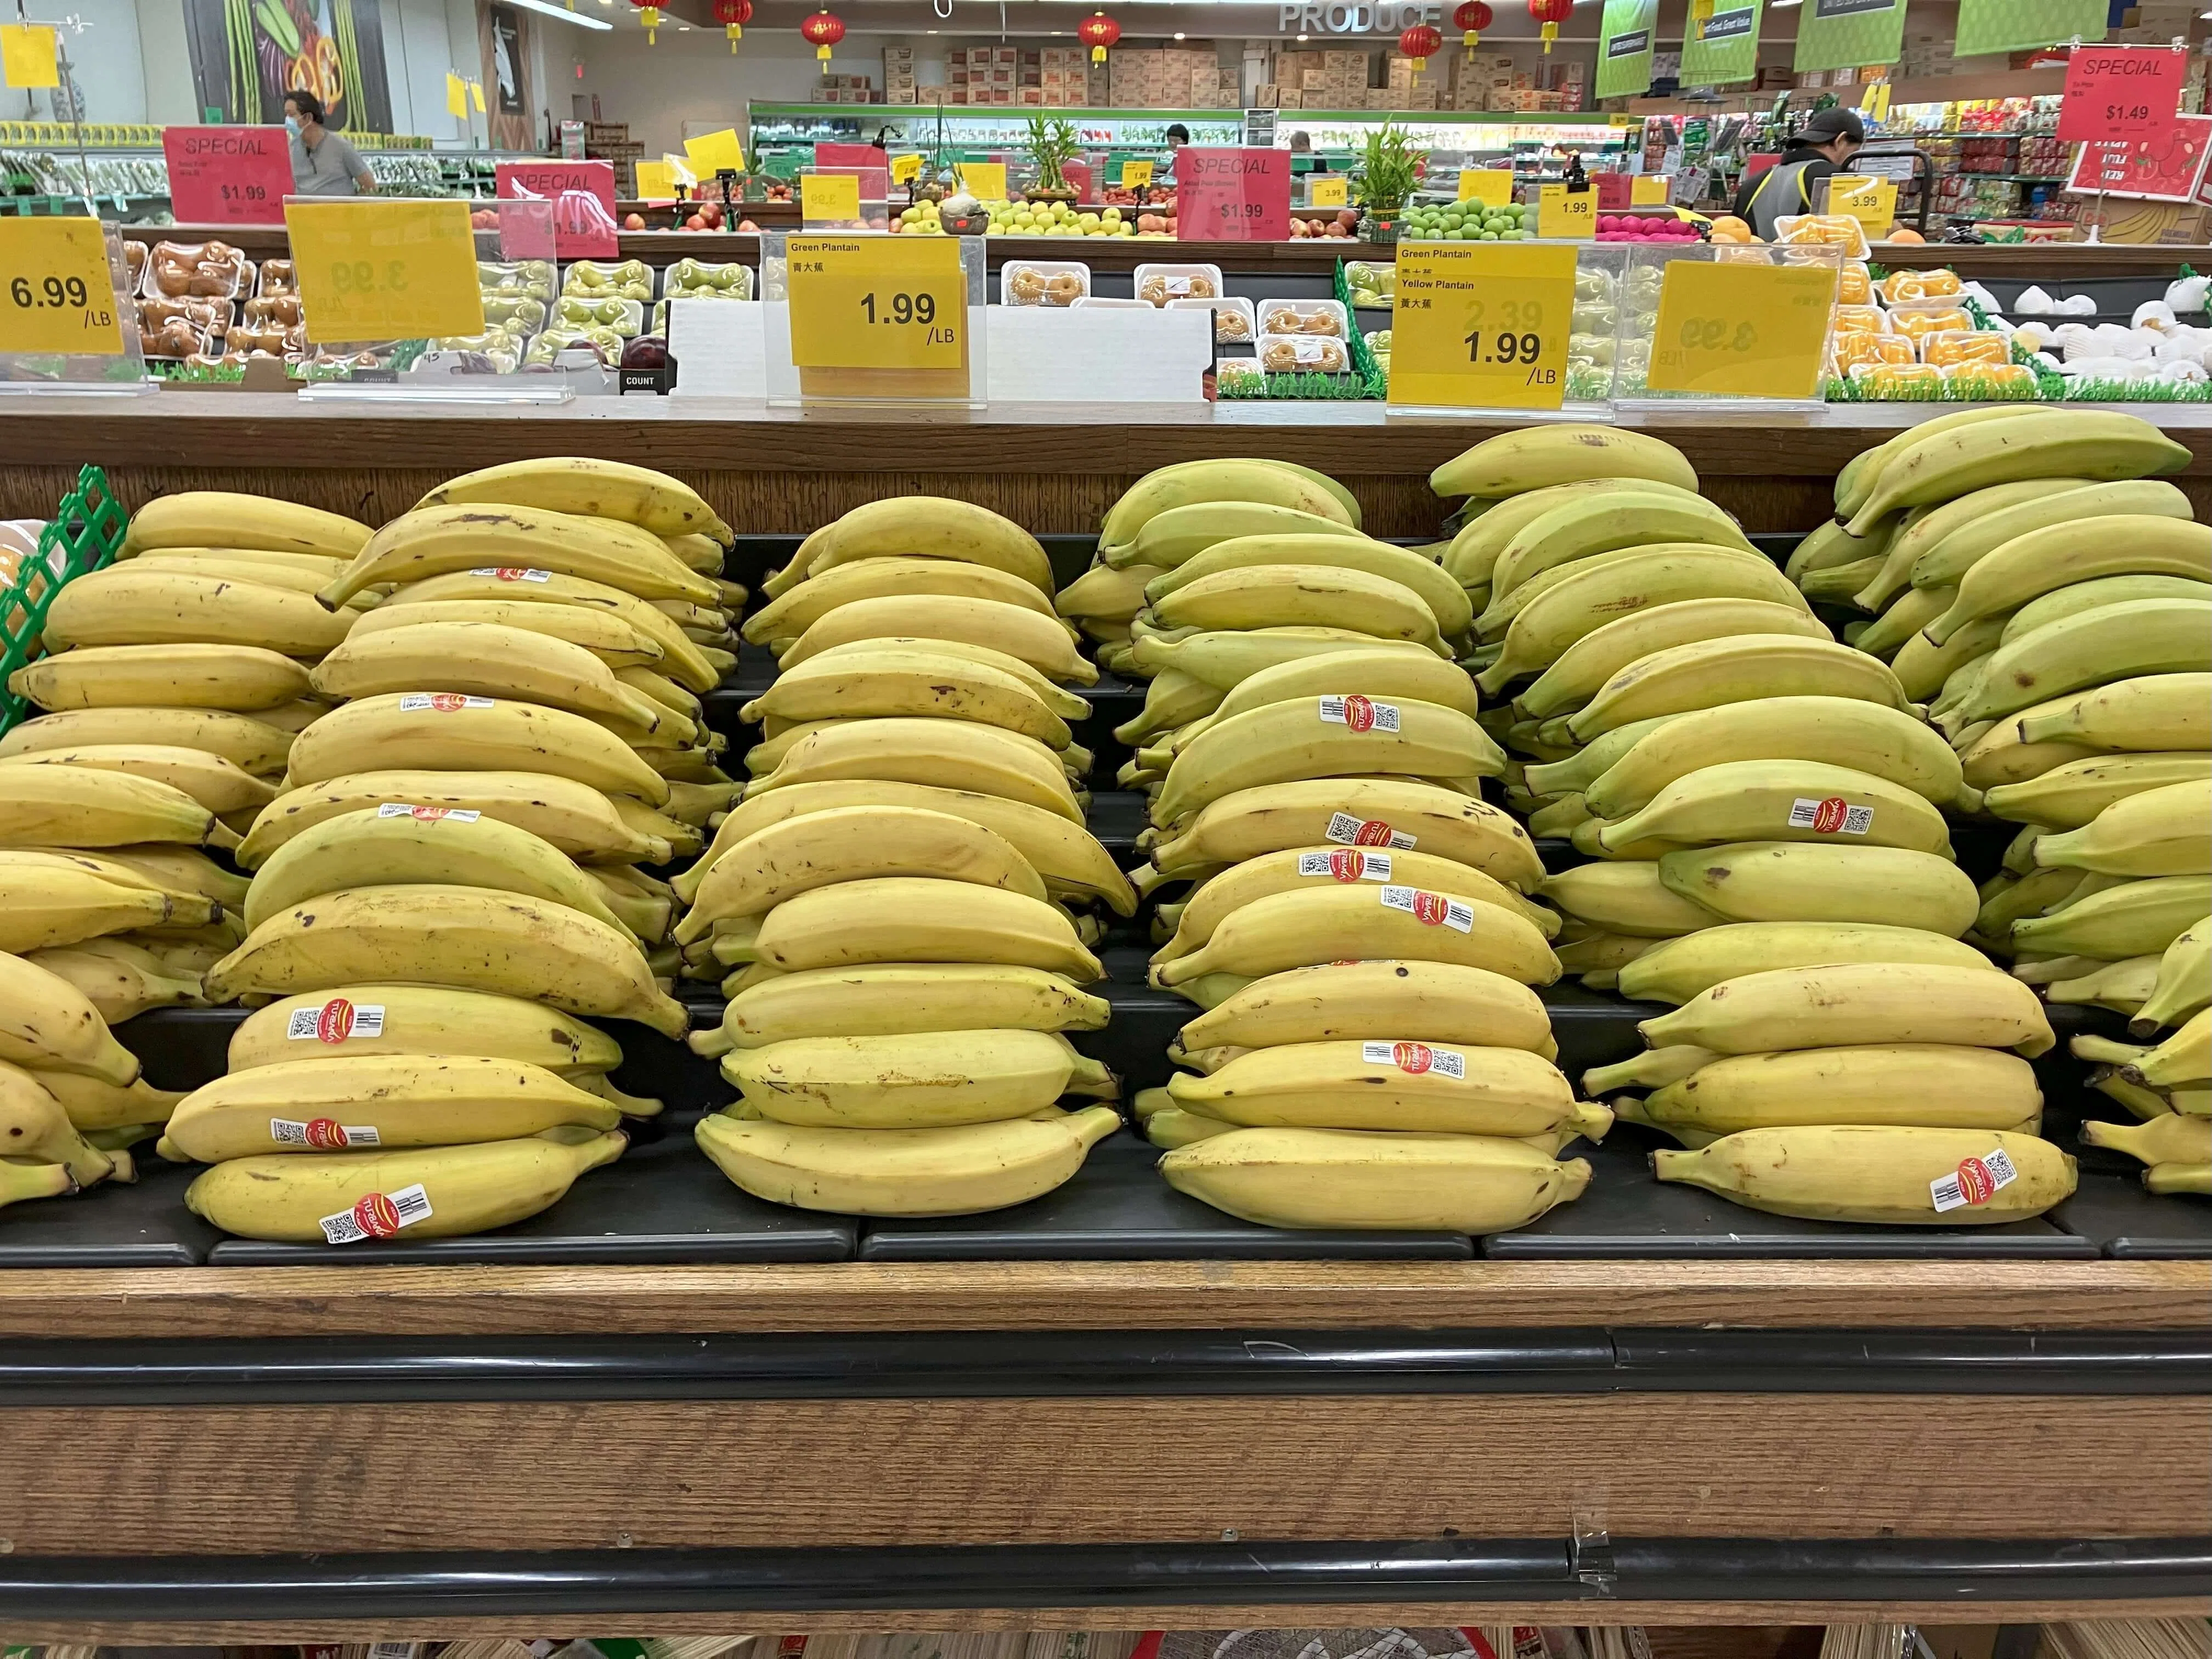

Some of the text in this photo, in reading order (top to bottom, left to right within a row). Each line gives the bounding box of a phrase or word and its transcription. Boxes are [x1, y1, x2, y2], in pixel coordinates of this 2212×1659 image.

[1279, 3, 1442, 32] PRODUCE
[2084, 59, 2162, 76] SPECIAL
[2106, 105, 2149, 120] $1.49
[185, 138, 268, 155] SPECIAL
[1193, 158, 1270, 174] SPECIAL
[1221, 203, 1263, 219] $1.99
[1562, 202, 1588, 213] 1.99
[1852, 196, 1877, 207] 3.99
[791, 243, 860, 252] Green Plantain
[1402, 250, 1471, 258] Green Plantain
[11, 276, 87, 308] 6.99
[1402, 279, 1474, 290] Yellow Plantain
[861, 293, 935, 324] 1.99
[84, 309, 111, 329] /LB
[927, 326, 955, 346] /LB
[1464, 331, 1541, 364] 1.99
[626, 377, 654, 385] COUNT
[1526, 367, 1556, 386] /LB
[1824, 799, 1841, 832] TURBANA
[1364, 823, 1381, 845] TURBA
[328, 1001, 340, 1042] TURBANA
[1968, 1159, 1987, 1201] TURBANA
[363, 1198, 385, 1237] TURBANA
